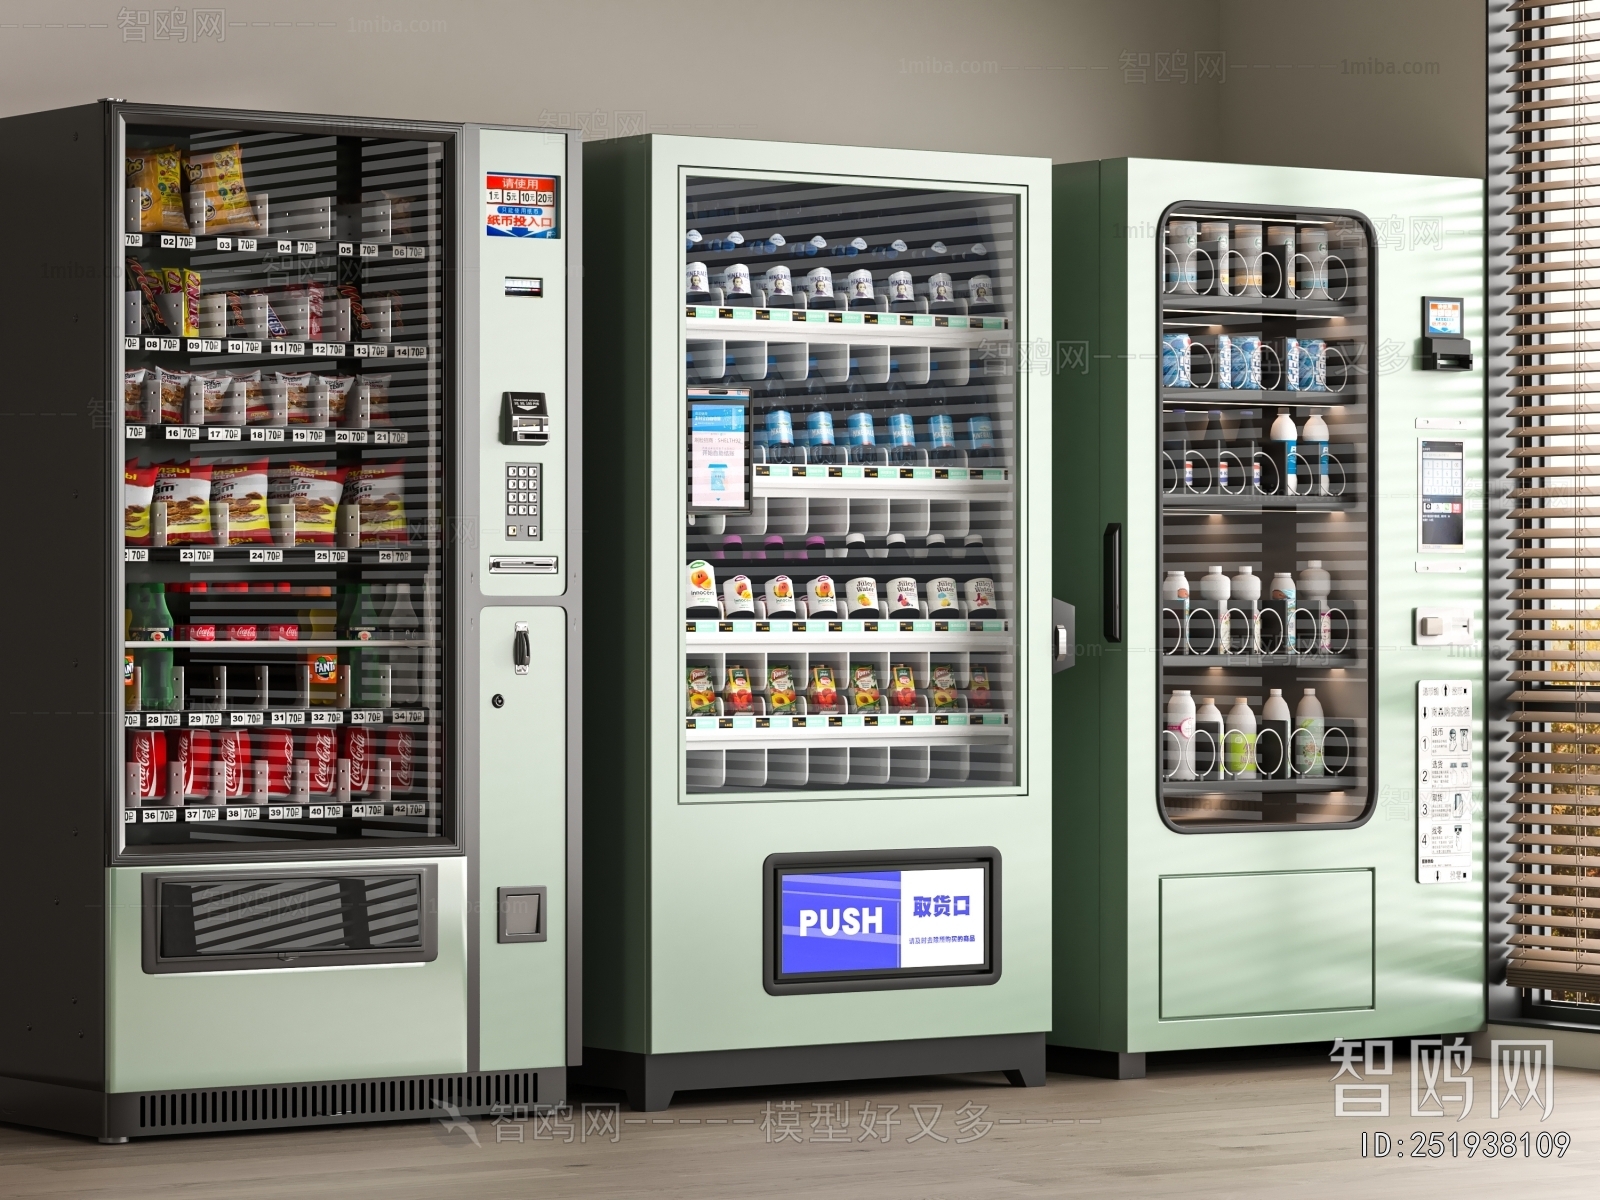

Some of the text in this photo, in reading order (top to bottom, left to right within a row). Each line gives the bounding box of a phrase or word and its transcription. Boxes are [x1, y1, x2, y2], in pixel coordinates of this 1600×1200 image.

[502, 178, 539, 190] 请使用
[489, 191, 553, 203] 1元 5元 10元 20元
[487, 215, 552, 227] 纸币投入口
[1422, 738, 1426, 749] 1
[1422, 770, 1428, 783] 2
[1422, 803, 1428, 815] 3
[1422, 834, 1427, 846] 4
[913, 895, 970, 918] 取货口
[800, 906, 883, 937] PUSH
